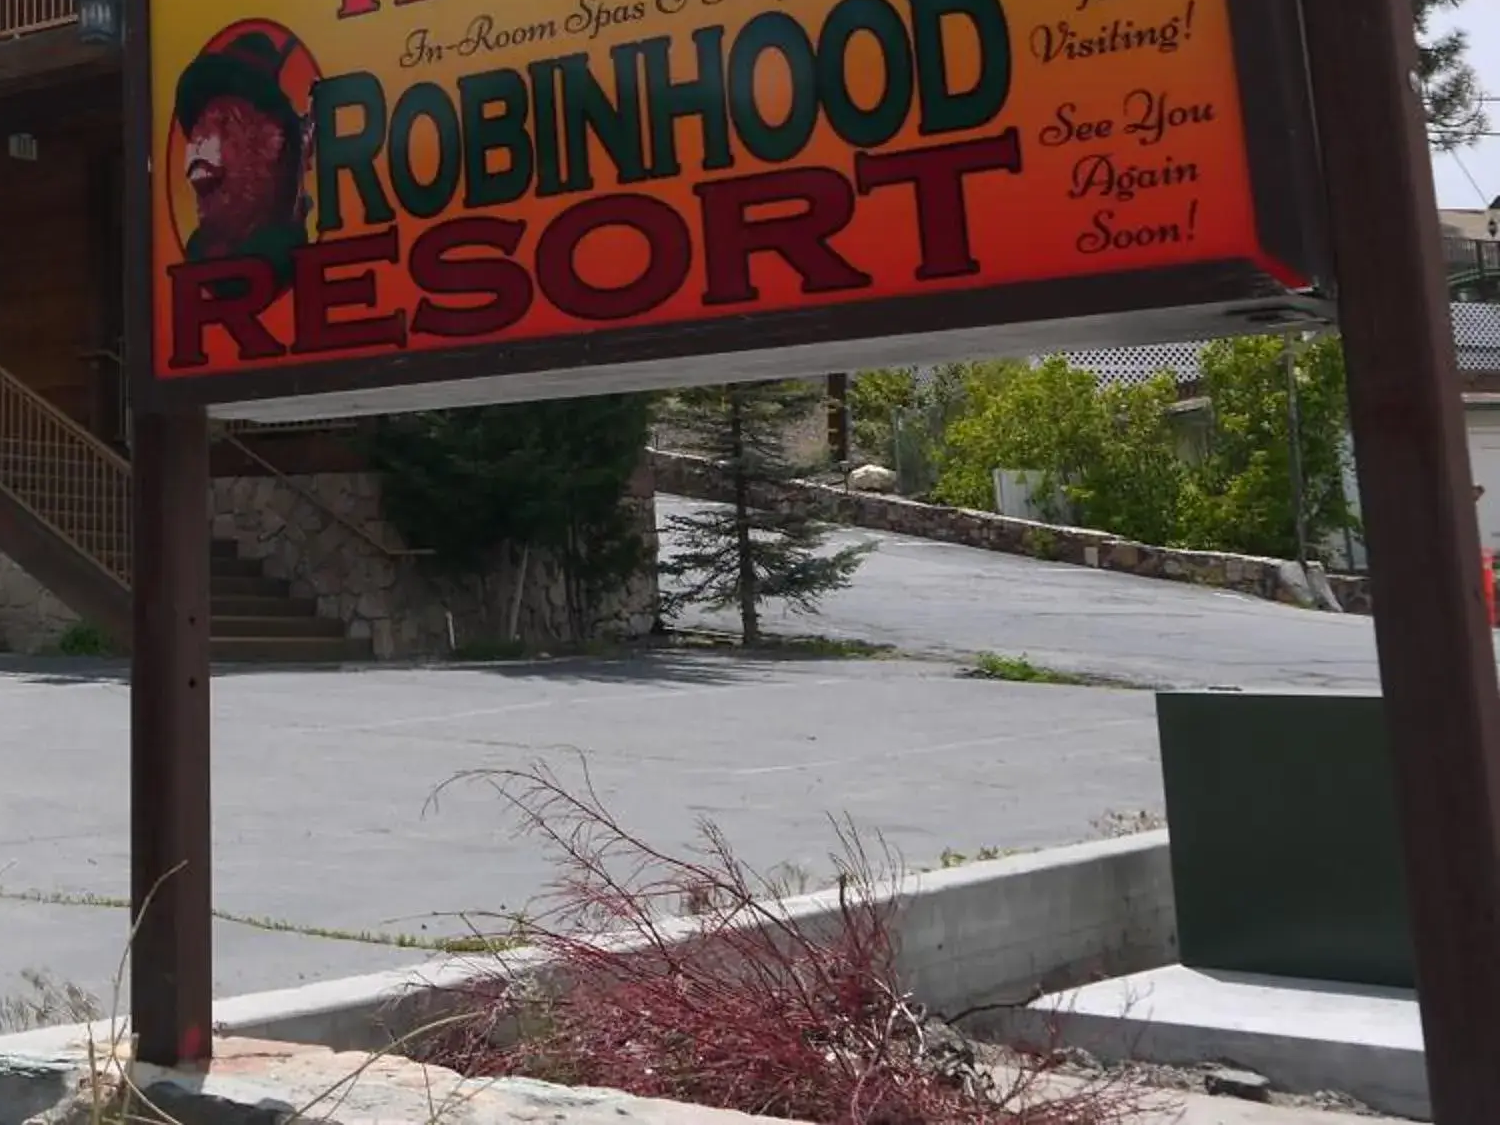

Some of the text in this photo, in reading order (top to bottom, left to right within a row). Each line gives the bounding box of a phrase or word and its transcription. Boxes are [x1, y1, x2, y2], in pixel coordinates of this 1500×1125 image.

[400, 15, 556, 67] In-Room
[1030, 0, 1195, 63] Visiting!
[1039, 88, 1216, 147] See You
[1068, 154, 1199, 201] Again
[167, 128, 1022, 369] RESORT
[1075, 200, 1198, 253] Soon!
